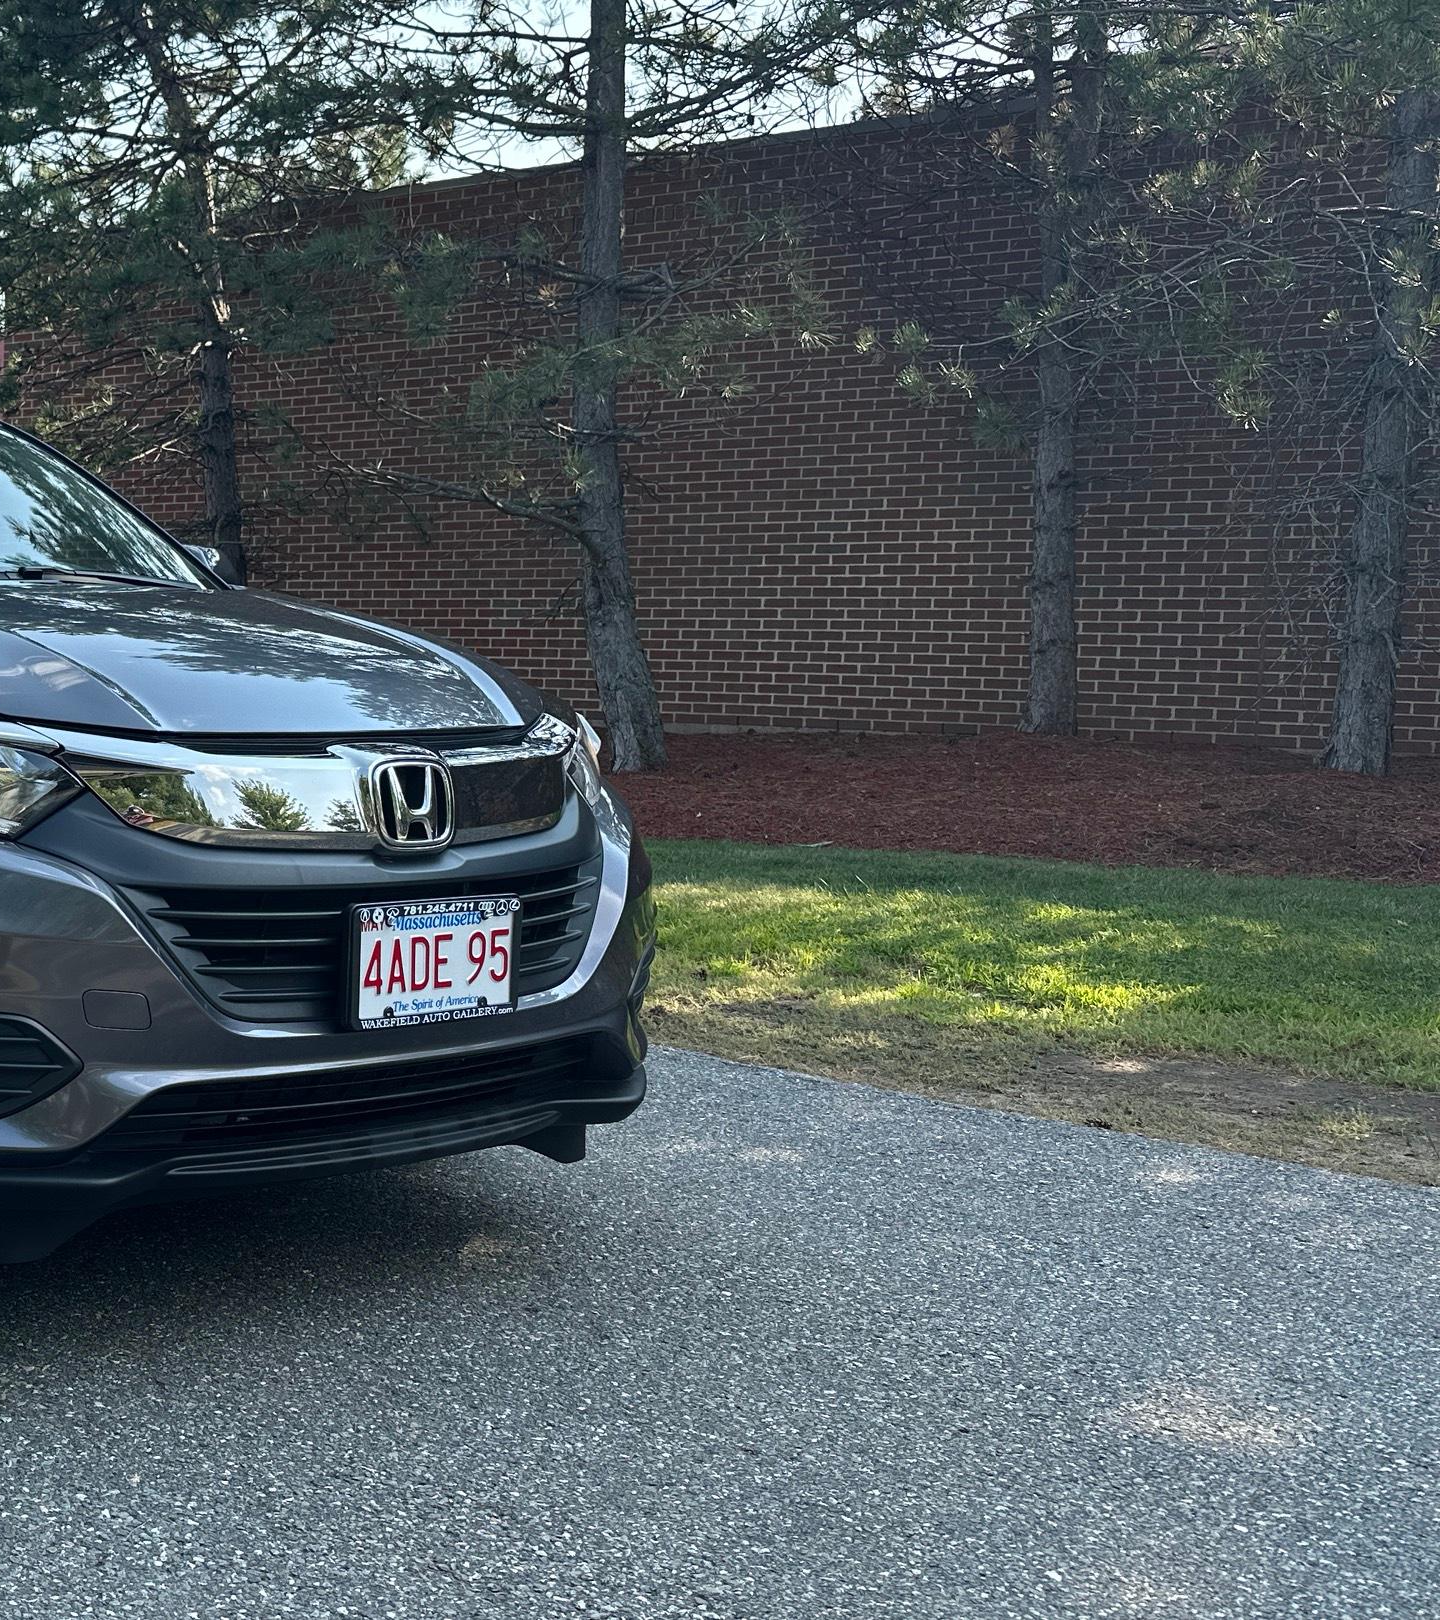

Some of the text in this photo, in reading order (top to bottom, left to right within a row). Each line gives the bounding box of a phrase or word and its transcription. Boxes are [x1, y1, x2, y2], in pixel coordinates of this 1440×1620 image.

[403, 902, 474, 916] 781.245.4711
[392, 911, 482, 931] Massachusetts
[363, 928, 510, 994] 4ADE 95
[393, 1001, 410, 1013] The
[411, 998, 433, 1012] Spirit
[435, 995, 445, 1009] of
[361, 1015, 421, 1030] WAKEFIELD
[422, 1010, 451, 1024] AUTO
